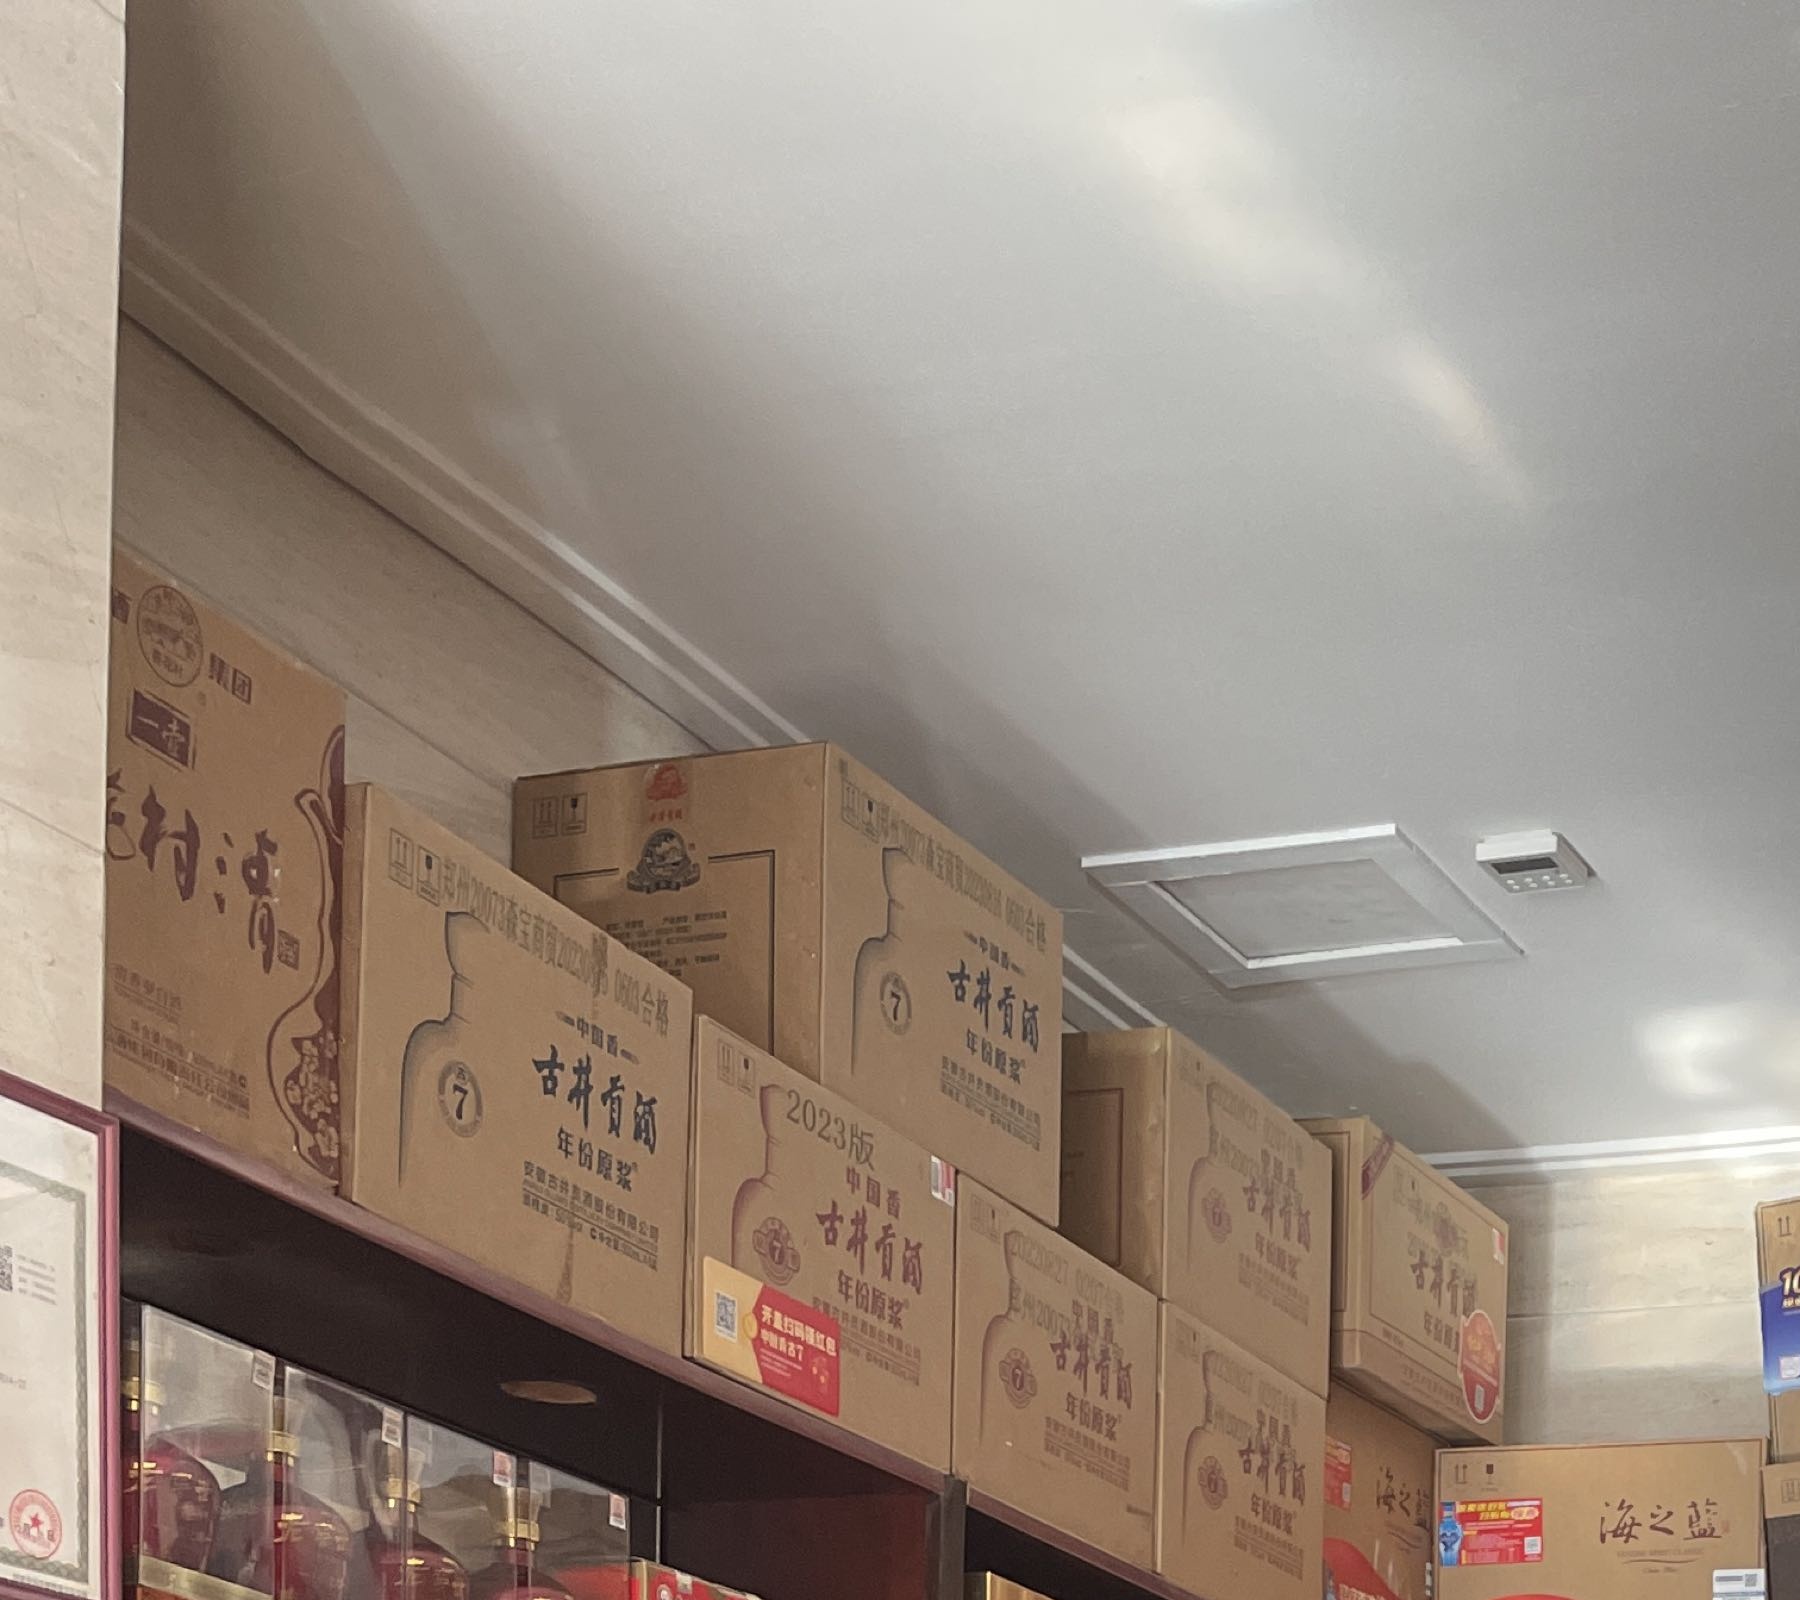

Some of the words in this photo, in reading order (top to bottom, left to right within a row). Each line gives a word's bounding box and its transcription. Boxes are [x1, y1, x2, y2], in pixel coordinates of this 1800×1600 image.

[891, 991, 901, 1021] 7
[947, 959, 1040, 1053] 古井贡酒
[967, 1028, 1022, 1085] 年份原浆
[452, 1082, 468, 1121] 7
[532, 1045, 658, 1155] 古井贡酒
[786, 1089, 875, 1170] 2023版
[557, 1126, 633, 1193] 年份原浆
[846, 1167, 900, 1218] 中国香
[816, 1200, 922, 1295] 古井贡酒
[838, 1269, 903, 1330] 年份原浆
